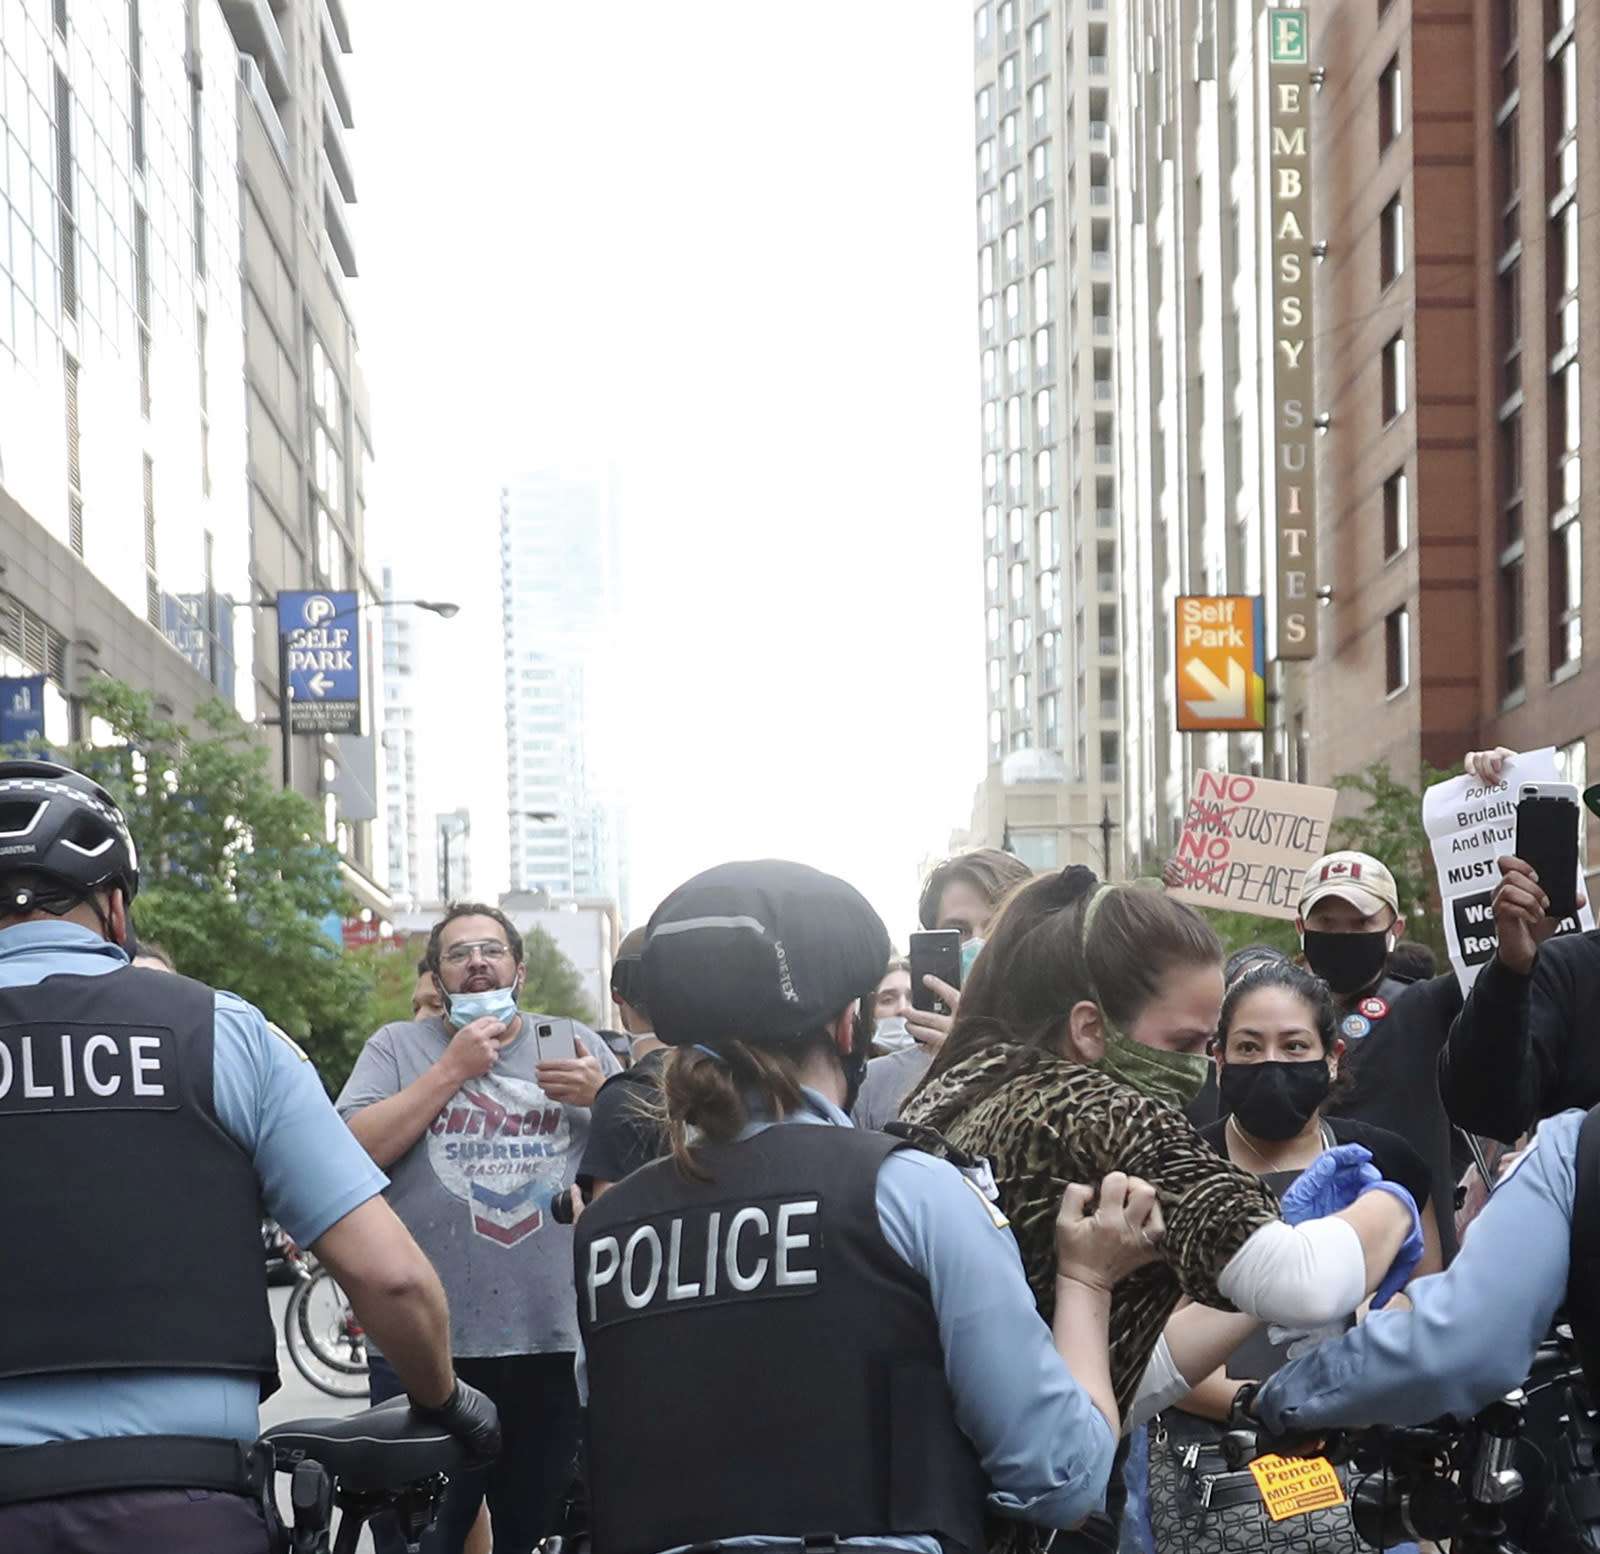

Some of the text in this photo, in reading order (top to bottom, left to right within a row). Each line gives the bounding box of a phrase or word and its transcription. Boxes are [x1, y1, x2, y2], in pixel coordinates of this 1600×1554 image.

[1272, 83, 1309, 645] EMBASSY SUITES
[1182, 599, 1237, 625] Self
[291, 628, 350, 650] SELF
[1183, 624, 1245, 649] Park
[288, 650, 354, 671] PARK
[1198, 771, 1256, 804] NO
[1456, 801, 1519, 828] Brutality
[1234, 805, 1326, 855] JUSTICE
[1451, 825, 1515, 854] And Mur
[1178, 830, 1231, 860] NO
[1223, 861, 1307, 909] PEACE
[1447, 859, 1495, 885] MUST
[588, 1200, 820, 1323] POLICE
[1253, 1455, 1305, 1473] Trum
[1264, 1461, 1322, 1486] Pence
[1266, 1479, 1306, 1501] MUST
[1309, 1472, 1335, 1488] GO!
